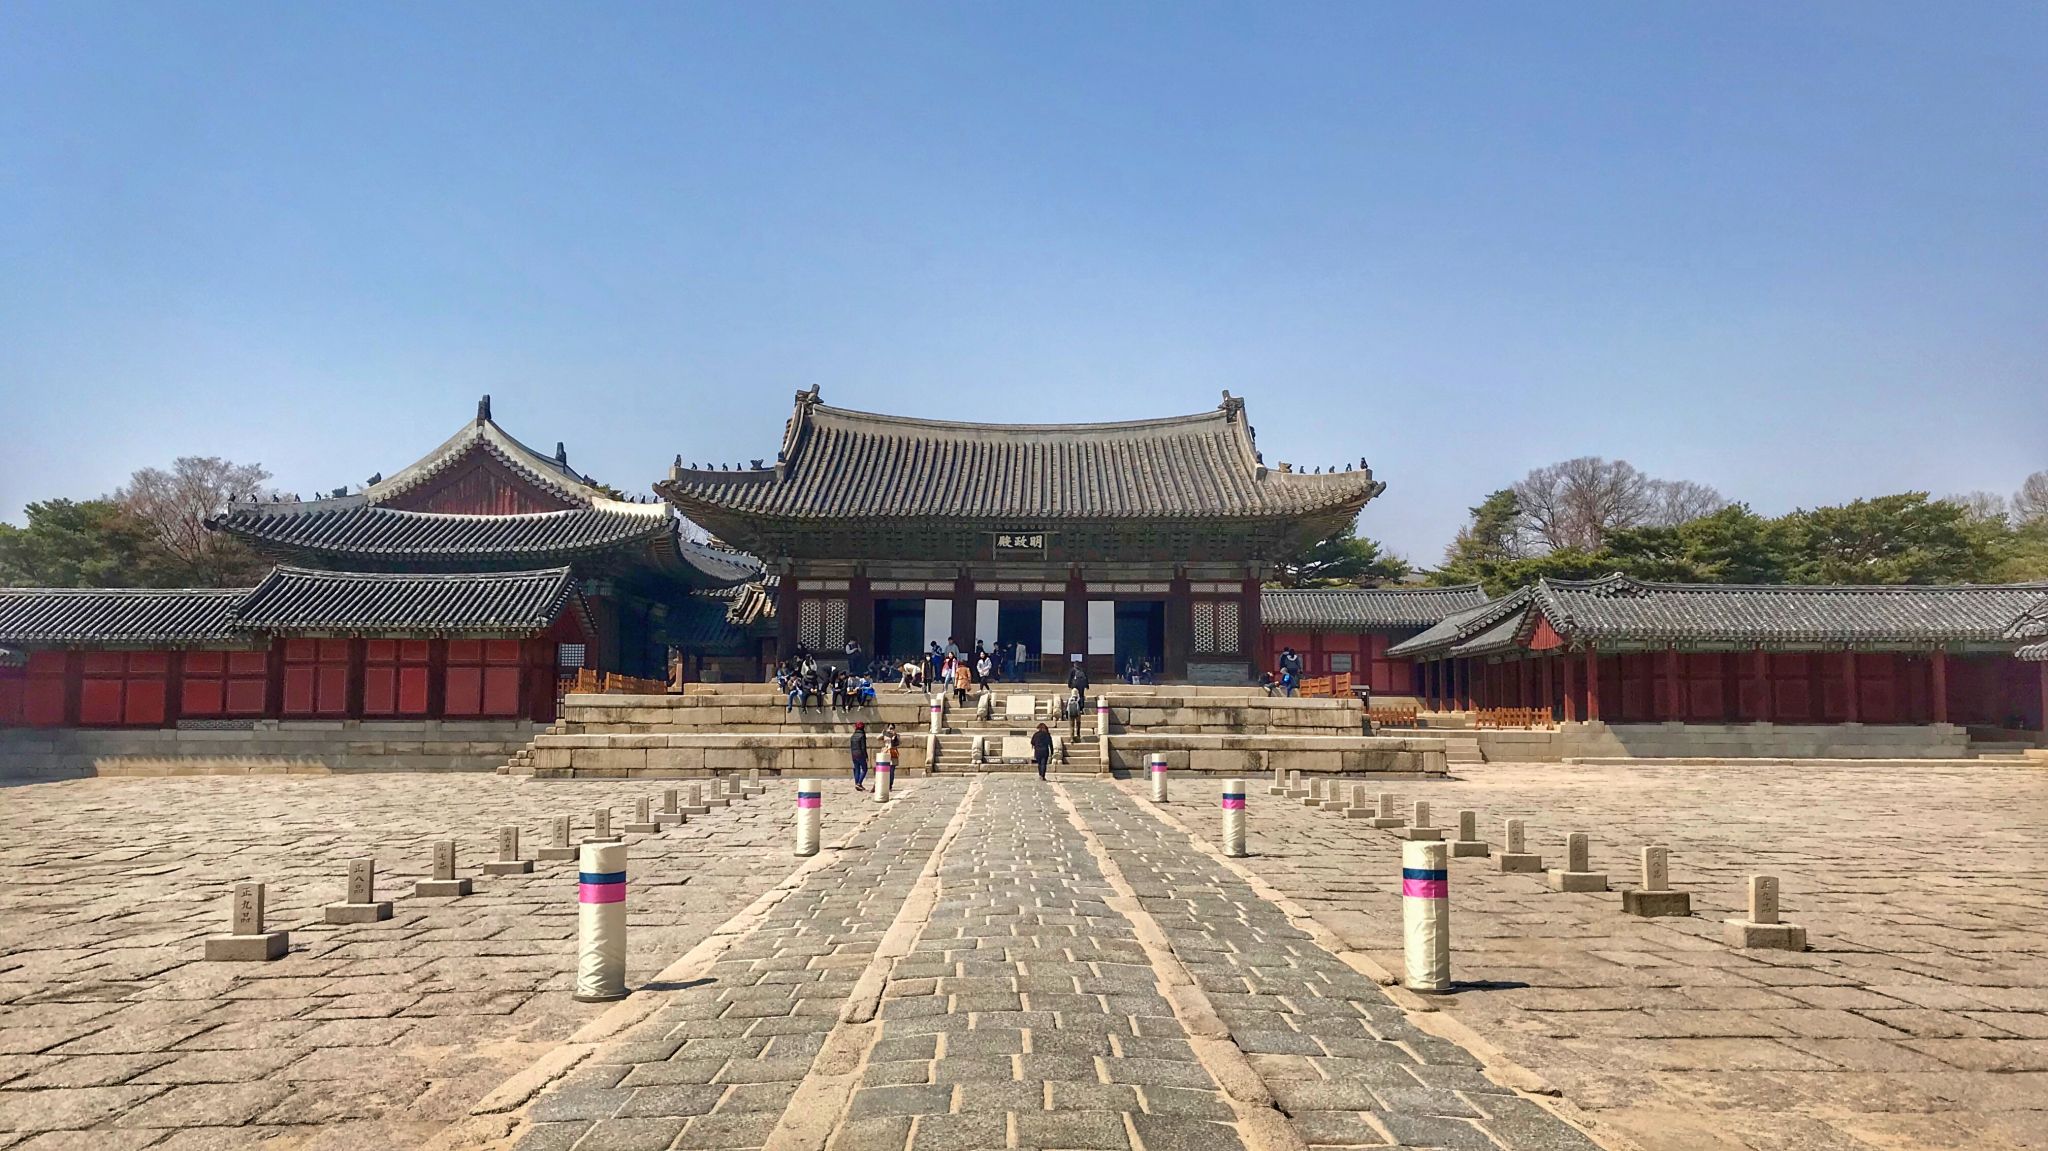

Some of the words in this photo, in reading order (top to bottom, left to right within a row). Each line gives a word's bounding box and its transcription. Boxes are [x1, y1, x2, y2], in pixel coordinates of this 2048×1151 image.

[438, 843, 448, 870] 正七品
[1650, 850, 1662, 879] 正八品
[353, 863, 366, 894] 正八品
[240, 887, 253, 924] 正九品
[1760, 880, 1773, 914] 正九品
